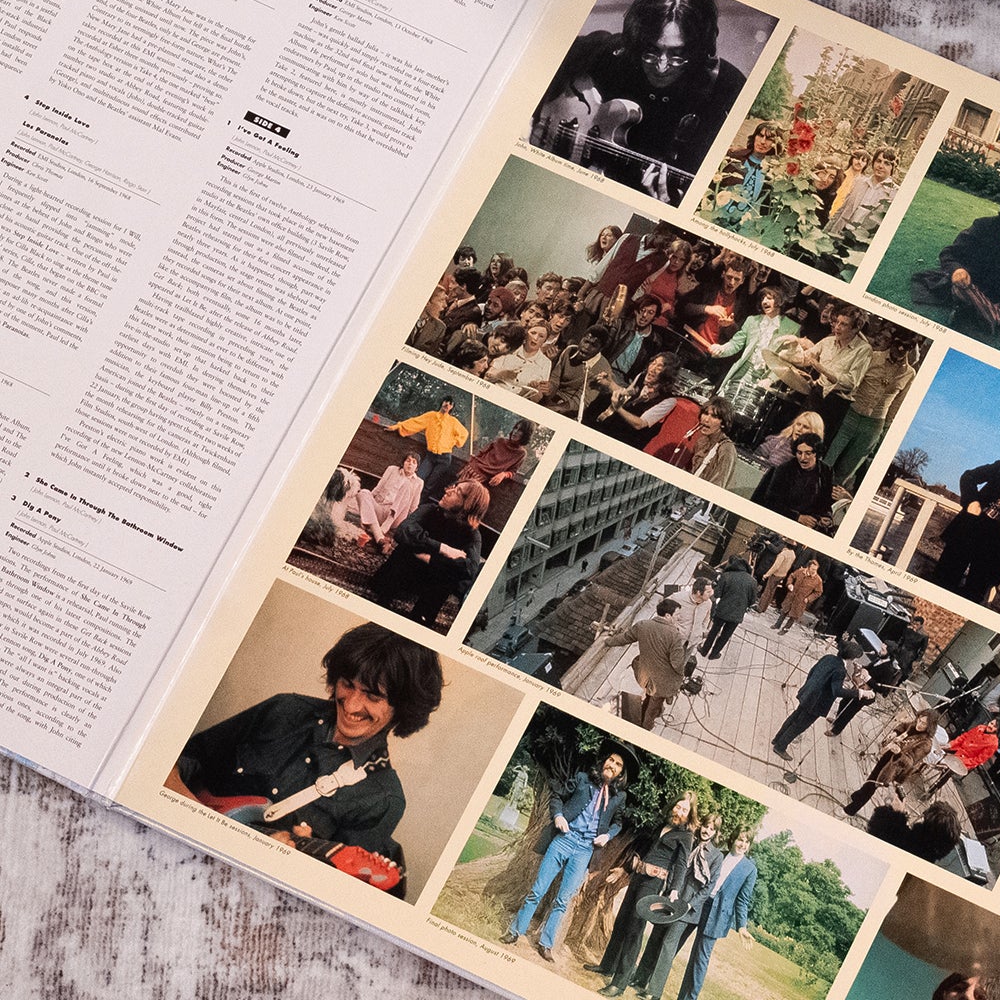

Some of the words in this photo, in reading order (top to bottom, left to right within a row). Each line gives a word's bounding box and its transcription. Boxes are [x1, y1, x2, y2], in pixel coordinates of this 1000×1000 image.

[34, 99, 50, 110] Step
[51, 106, 72, 120] Inside
[73, 116, 90, 128] Love
[252, 116, 273, 129] SIDE
[22, 120, 34, 129] Los
[34, 126, 69, 145] Paranoias
[236, 124, 251, 135] I've
[252, 132, 266, 141] Got
[273, 141, 299, 158] Feeling
[21, 499, 34, 511] Dig
[42, 510, 61, 523] Pony
[35, 476, 48, 486] She
[49, 483, 68, 496] Came
[69, 492, 77, 500] In
[78, 496, 106, 514] Through
[107, 511, 120, 521] The
[120, 518, 154, 538] Bathroom
[156, 534, 184, 552] Window
